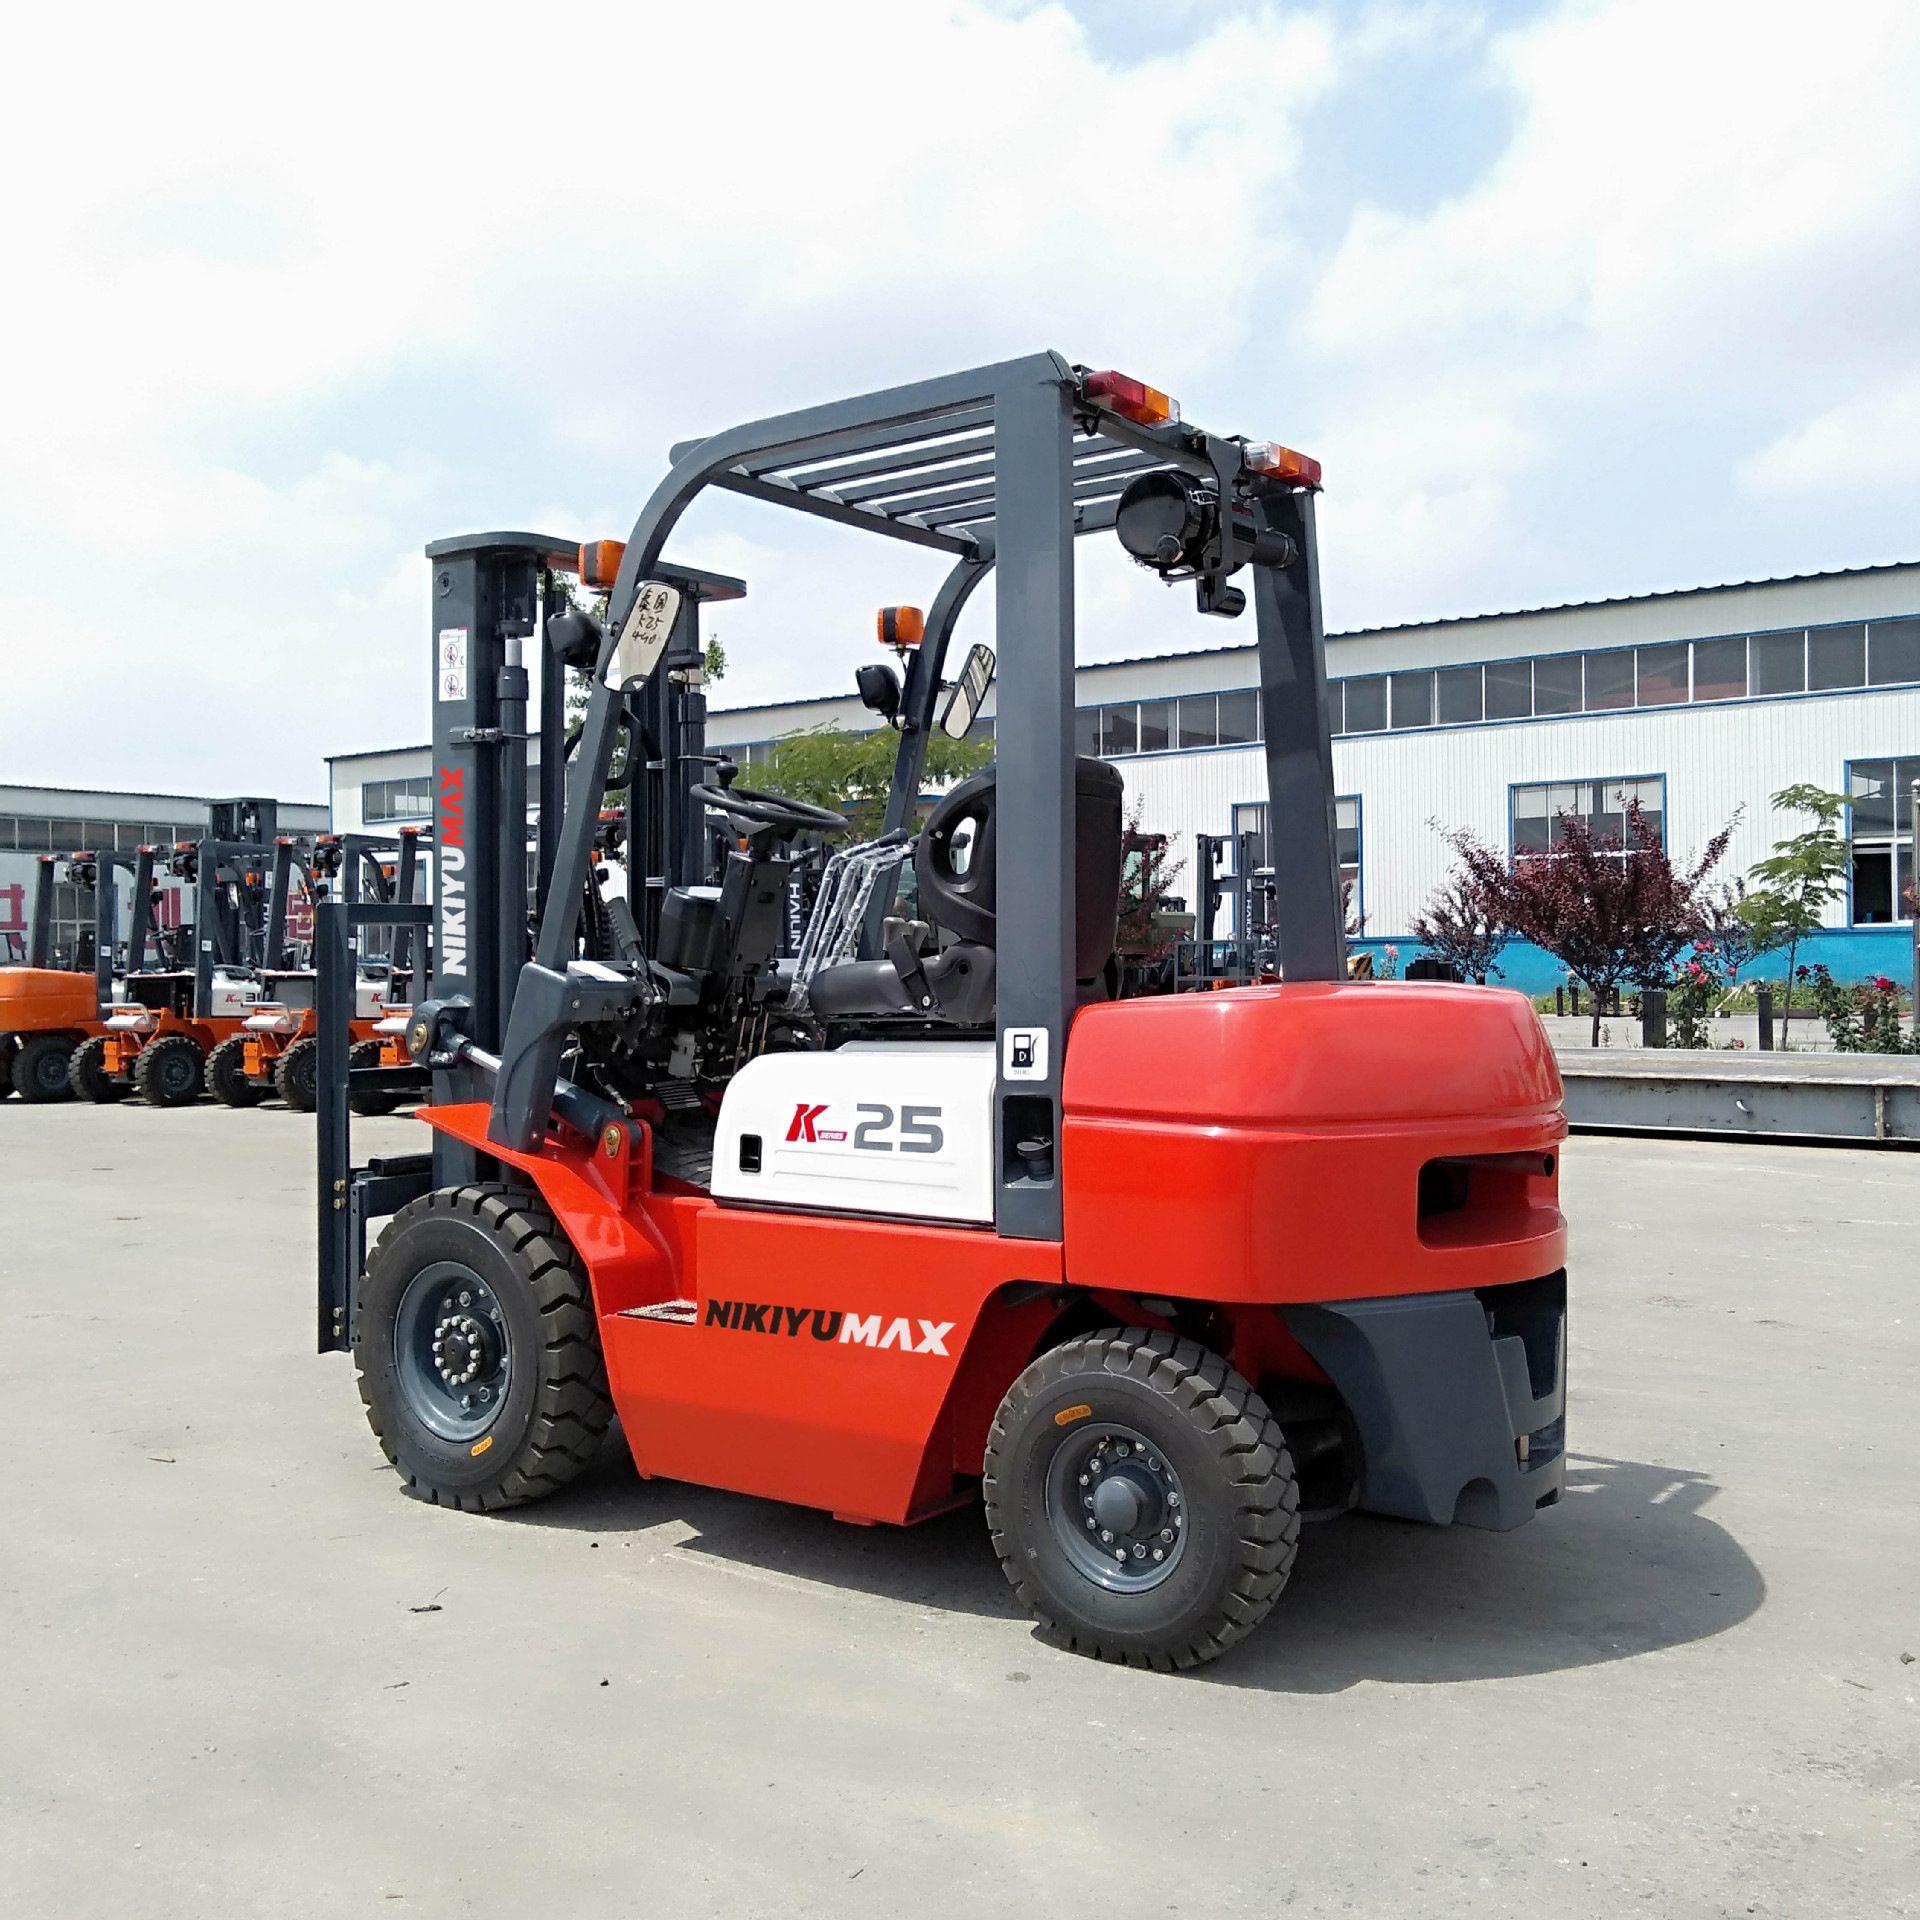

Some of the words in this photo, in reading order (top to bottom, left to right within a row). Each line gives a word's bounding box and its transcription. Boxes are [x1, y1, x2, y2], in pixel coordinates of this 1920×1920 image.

[440, 765, 467, 976] NIKIYUMAX
[1018, 1051, 1027, 1062] D
[853, 1103, 944, 1154] 25
[704, 1298, 957, 1357] NIKIYUMAX
